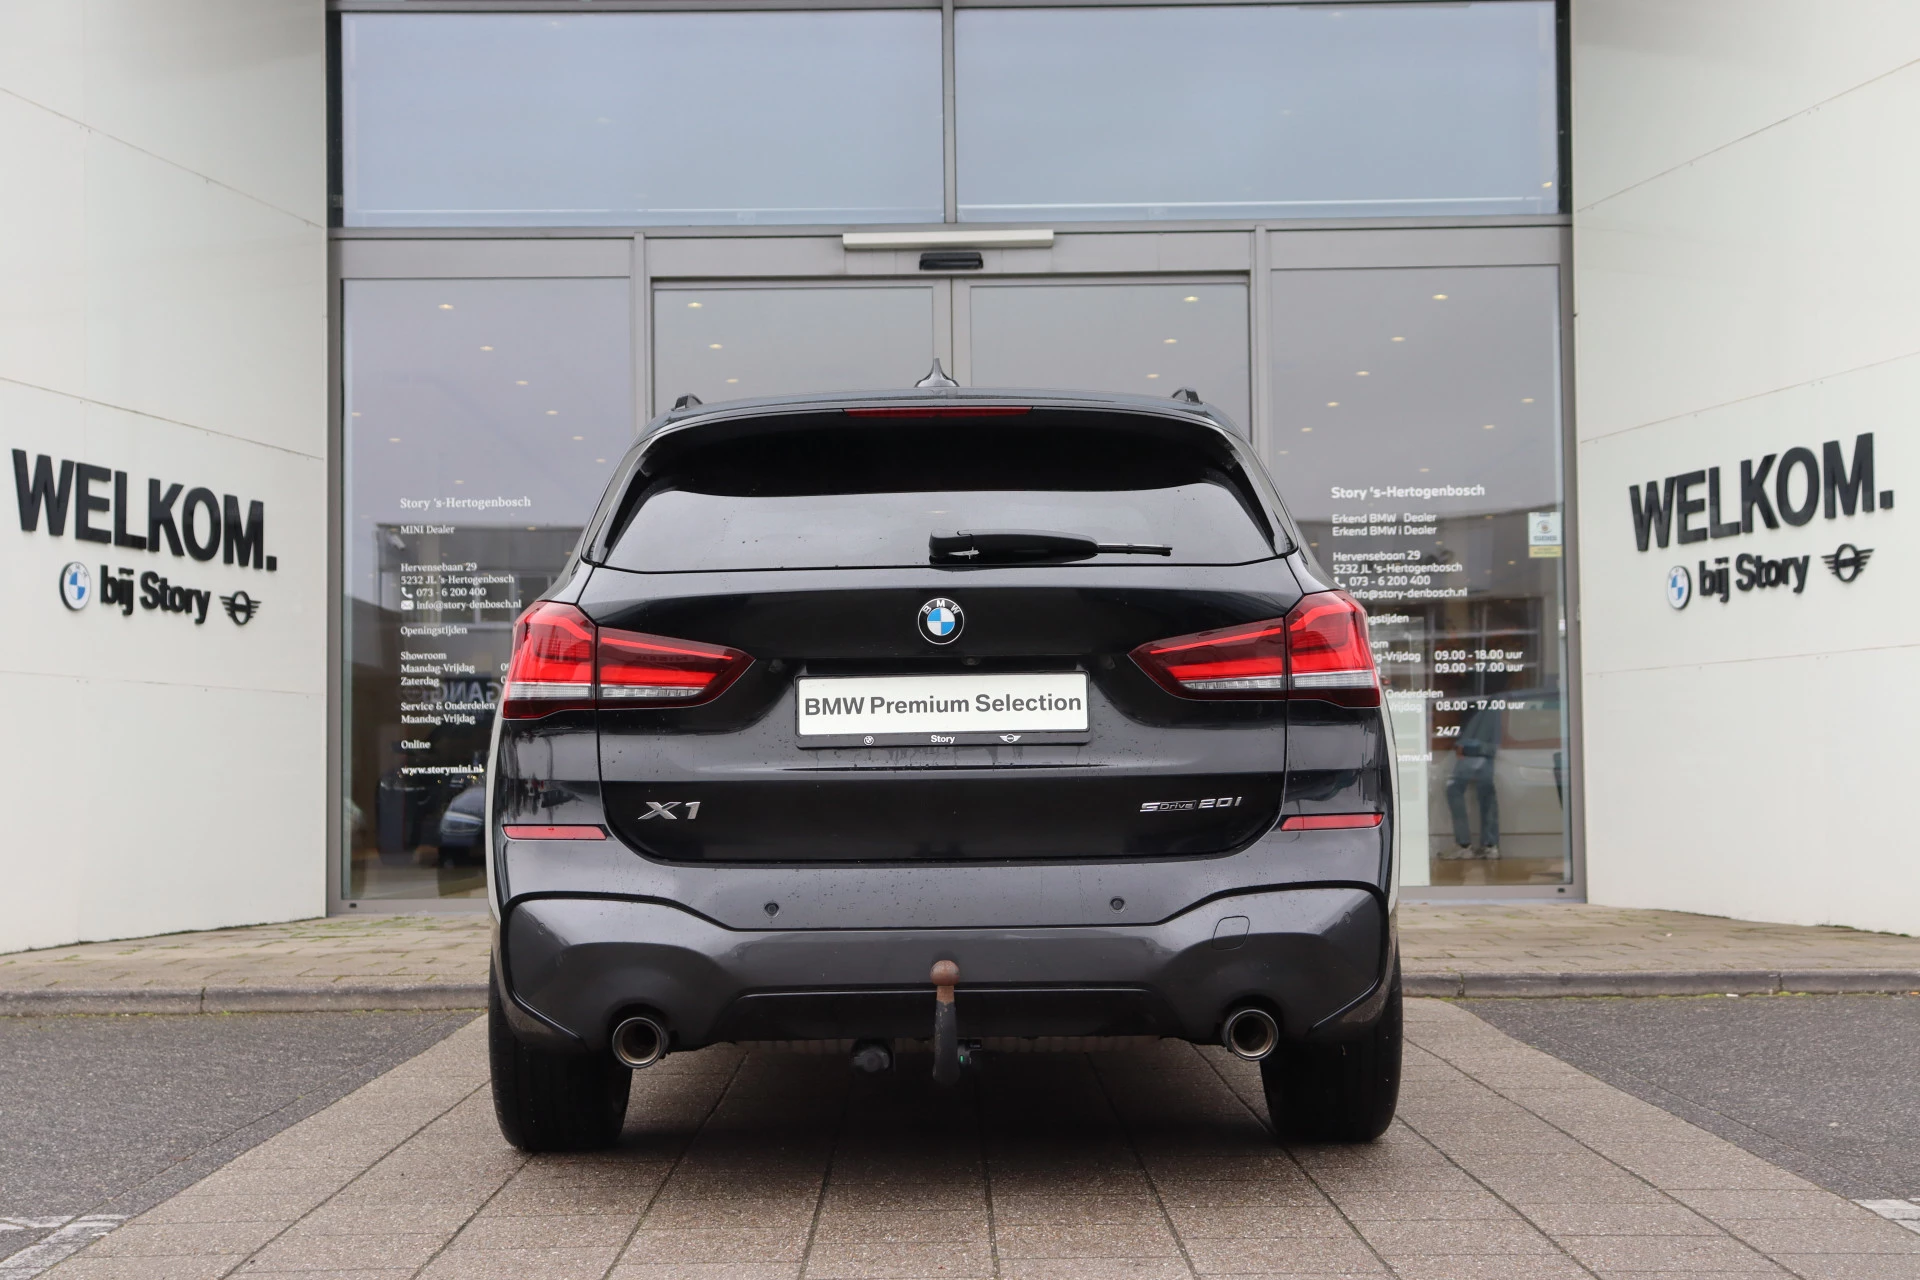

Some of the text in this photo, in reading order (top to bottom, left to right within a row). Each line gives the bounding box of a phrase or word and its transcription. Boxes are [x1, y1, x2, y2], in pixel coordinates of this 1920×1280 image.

[1331, 487, 1367, 500] Story
[1629, 432, 1893, 552] WELKOM.
[12, 448, 277, 571] WELKOM.
[400, 498, 431, 511] Story
[1332, 512, 1437, 523] Erkend BMW Dealer
[400, 525, 455, 534] MINI Dealer
[1332, 526, 1368, 536] Erkend
[1369, 526, 1397, 536] BMW
[1403, 525, 1438, 535] Dealer
[1333, 550, 1421, 561] Hervensebaan 29
[400, 562, 477, 572] Hervensebaan 29
[1333, 564, 1358, 574] 5232
[1360, 564, 1372, 574] JL
[401, 575, 423, 585] 5232
[425, 575, 437, 584] JL
[1349, 576, 1368, 586] 073
[1378, 576, 1385, 586] 6
[1387, 576, 1408, 586] 200
[1409, 575, 1431, 585] 400
[1699, 553, 1810, 603] bij Story
[100, 565, 211, 625] bij Story
[416, 588, 433, 597] 073
[441, 588, 448, 597] 6
[450, 588, 467, 597] 200
[469, 587, 487, 596] 400
[416, 599, 521, 611] info@story-denbosch.nl
[400, 626, 467, 637] Openingstijden
[400, 651, 447, 660] Showroom
[1434, 650, 1466, 660] 09.00
[1474, 649, 1504, 660] 18.00
[1505, 651, 1523, 660] uur
[401, 663, 475, 675] Maandag-Vrijdag
[1434, 663, 1466, 673] 09.00
[1506, 664, 1524, 672] uur
[401, 676, 440, 688] Zaterdag
[1385, 688, 1444, 699] Onderdelen
[401, 701, 496, 711] Service & Onderdelen
[804, 693, 1082, 716] BMW Premium Selection
[1435, 701, 1467, 711] 08.00
[1507, 702, 1525, 710] uur
[401, 714, 476, 725] Maandag-Vrijdag
[1436, 726, 1461, 737] 24/7
[401, 740, 431, 749] Online
[930, 735, 955, 744] Story
[401, 764, 483, 775] www.storymini.nl
[638, 801, 701, 820] X1
